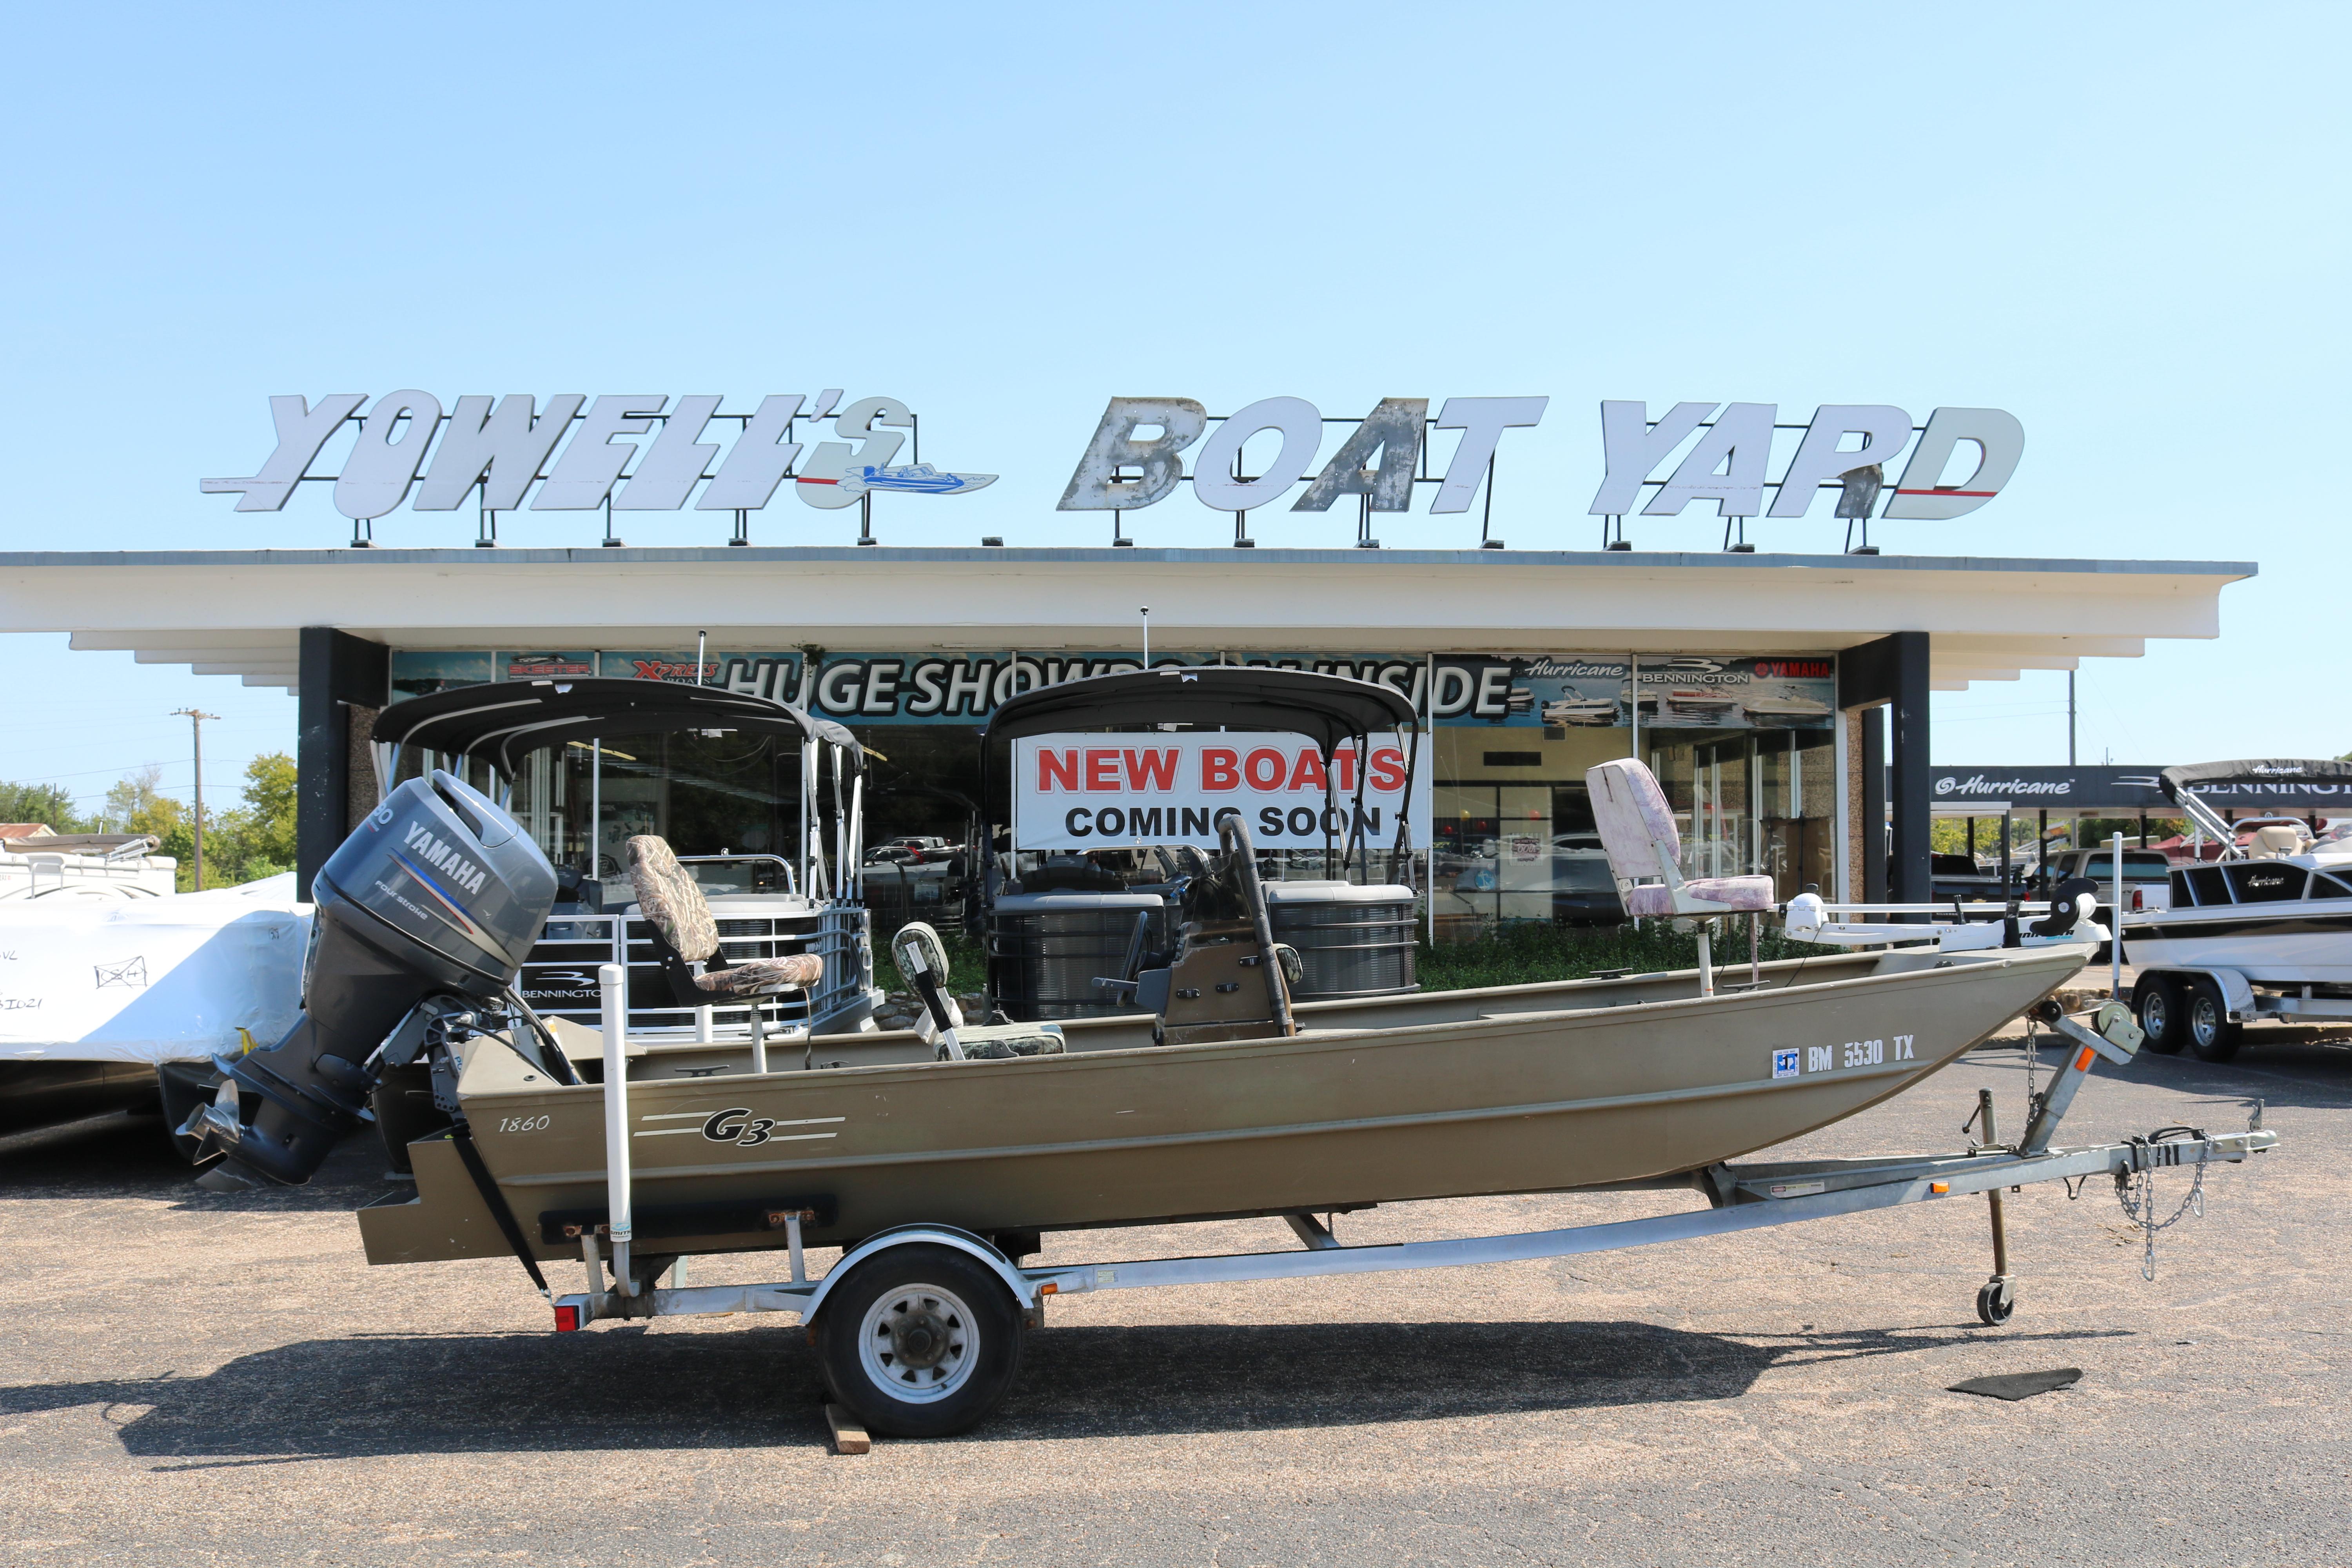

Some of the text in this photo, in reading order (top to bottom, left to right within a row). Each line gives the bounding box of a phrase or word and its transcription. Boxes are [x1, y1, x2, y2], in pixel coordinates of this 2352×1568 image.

[201, 388, 2025, 520] YOWELL'S BOAT YARD
[510, 664, 590, 674] SKEETER
[1524, 659, 1624, 677] Hurricane
[1642, 673, 1749, 684] BENNINGTON
[1771, 662, 1829, 677] YAMAHA
[728, 663, 900, 712] HUGE
[1037, 748, 1408, 793] NEW BOATS
[2252, 764, 2303, 774] Hurricane
[1955, 774, 2071, 795] Hurricane
[1258, 807, 1380, 836] SOON
[403, 820, 486, 895] YAMAHA
[522, 989, 602, 998] BENNINGTO
[1808, 1045, 1833, 1073] BM
[1844, 1039, 1883, 1068] 5530
[1893, 1034, 1914, 1061] TX
[499, 1114, 550, 1132] 1860
[702, 1107, 777, 1147] G3
